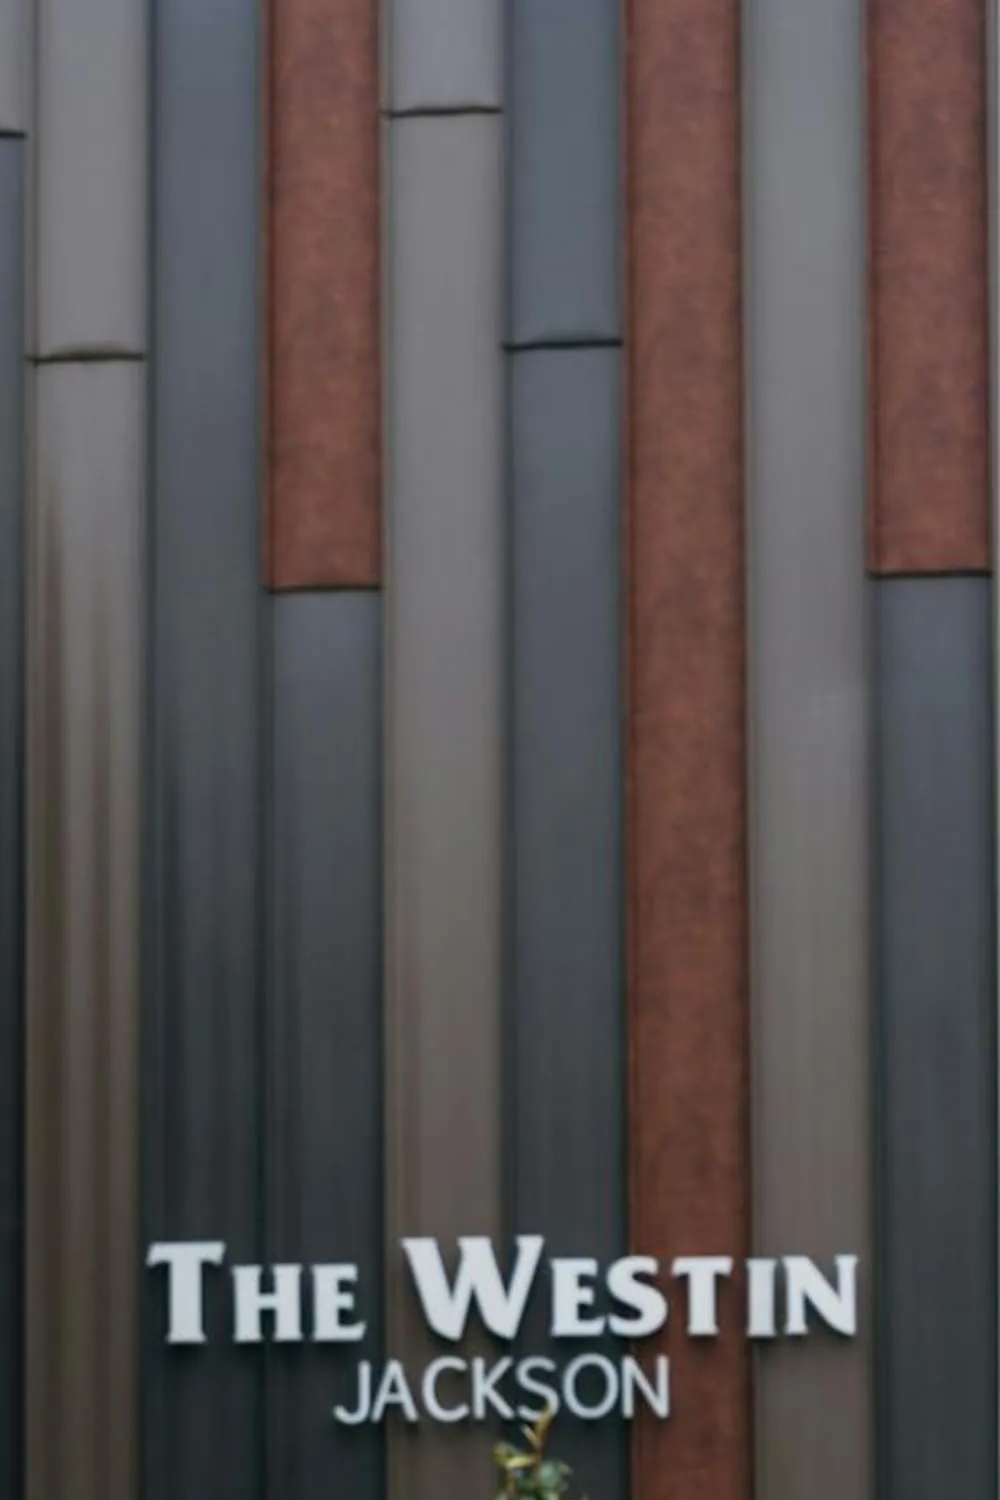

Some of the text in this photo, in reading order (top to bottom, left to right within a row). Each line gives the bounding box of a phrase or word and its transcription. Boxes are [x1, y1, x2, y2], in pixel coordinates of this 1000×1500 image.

[147, 1235, 858, 1343] THE WESTIN
[334, 1353, 671, 1425] JACKSON
